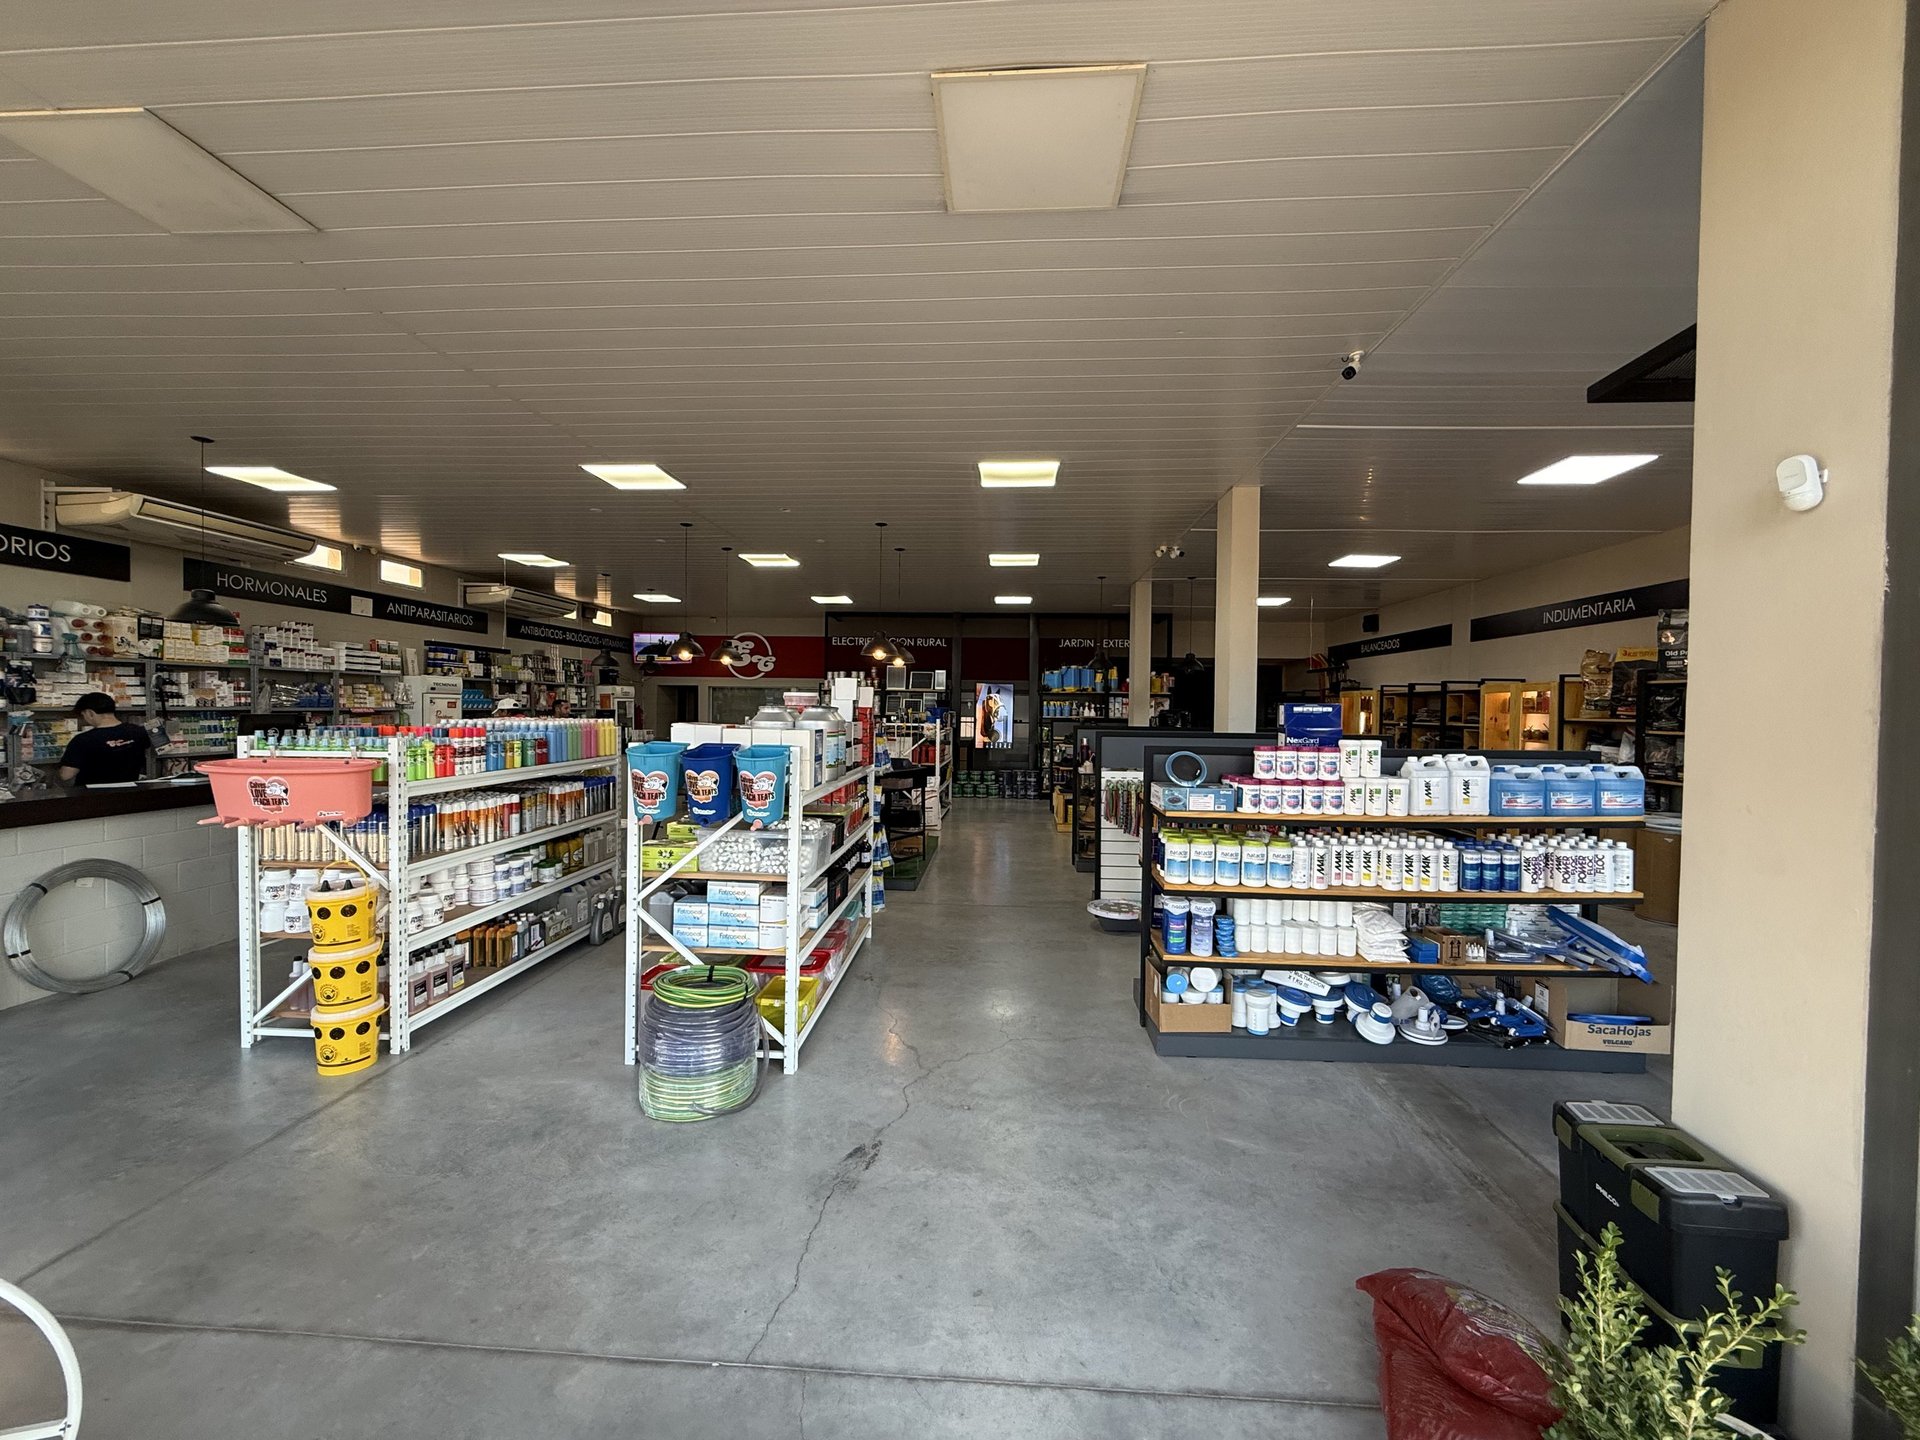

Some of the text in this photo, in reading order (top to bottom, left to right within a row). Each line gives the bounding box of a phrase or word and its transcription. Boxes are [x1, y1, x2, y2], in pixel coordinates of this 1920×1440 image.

[217, 572, 327, 603] HORMONALES
[387, 602, 474, 626] ANTIPARASITARIOS
[1543, 597, 1636, 625] INDUMENTARIA
[916, 638, 947, 647] RURAL
[1059, 639, 1094, 648] JARDIN
[1361, 638, 1400, 653] BALANCEADOS
[1286, 736, 1320, 744] NexGard
[251, 789, 267, 798] LOVE
[1463, 779, 1471, 798] MAK
[254, 798, 271, 806] PEACH
[1317, 853, 1326, 875] MAK
[1345, 850, 1354, 872] MAK
[1363, 850, 1371, 872] MAK
[1405, 854, 1414, 877] MAK
[1422, 854, 1430, 877] MAK
[1523, 856, 1531, 874] MAK
[1562, 856, 1571, 884] POWER
[1578, 855, 1587, 883] POWER
[1596, 854, 1605, 874] FLOC
[677, 908, 703, 916] Fatroseal
[1587, 1024, 1651, 1038] SacaHojas
[1595, 1182, 1620, 1207] PHILCO
